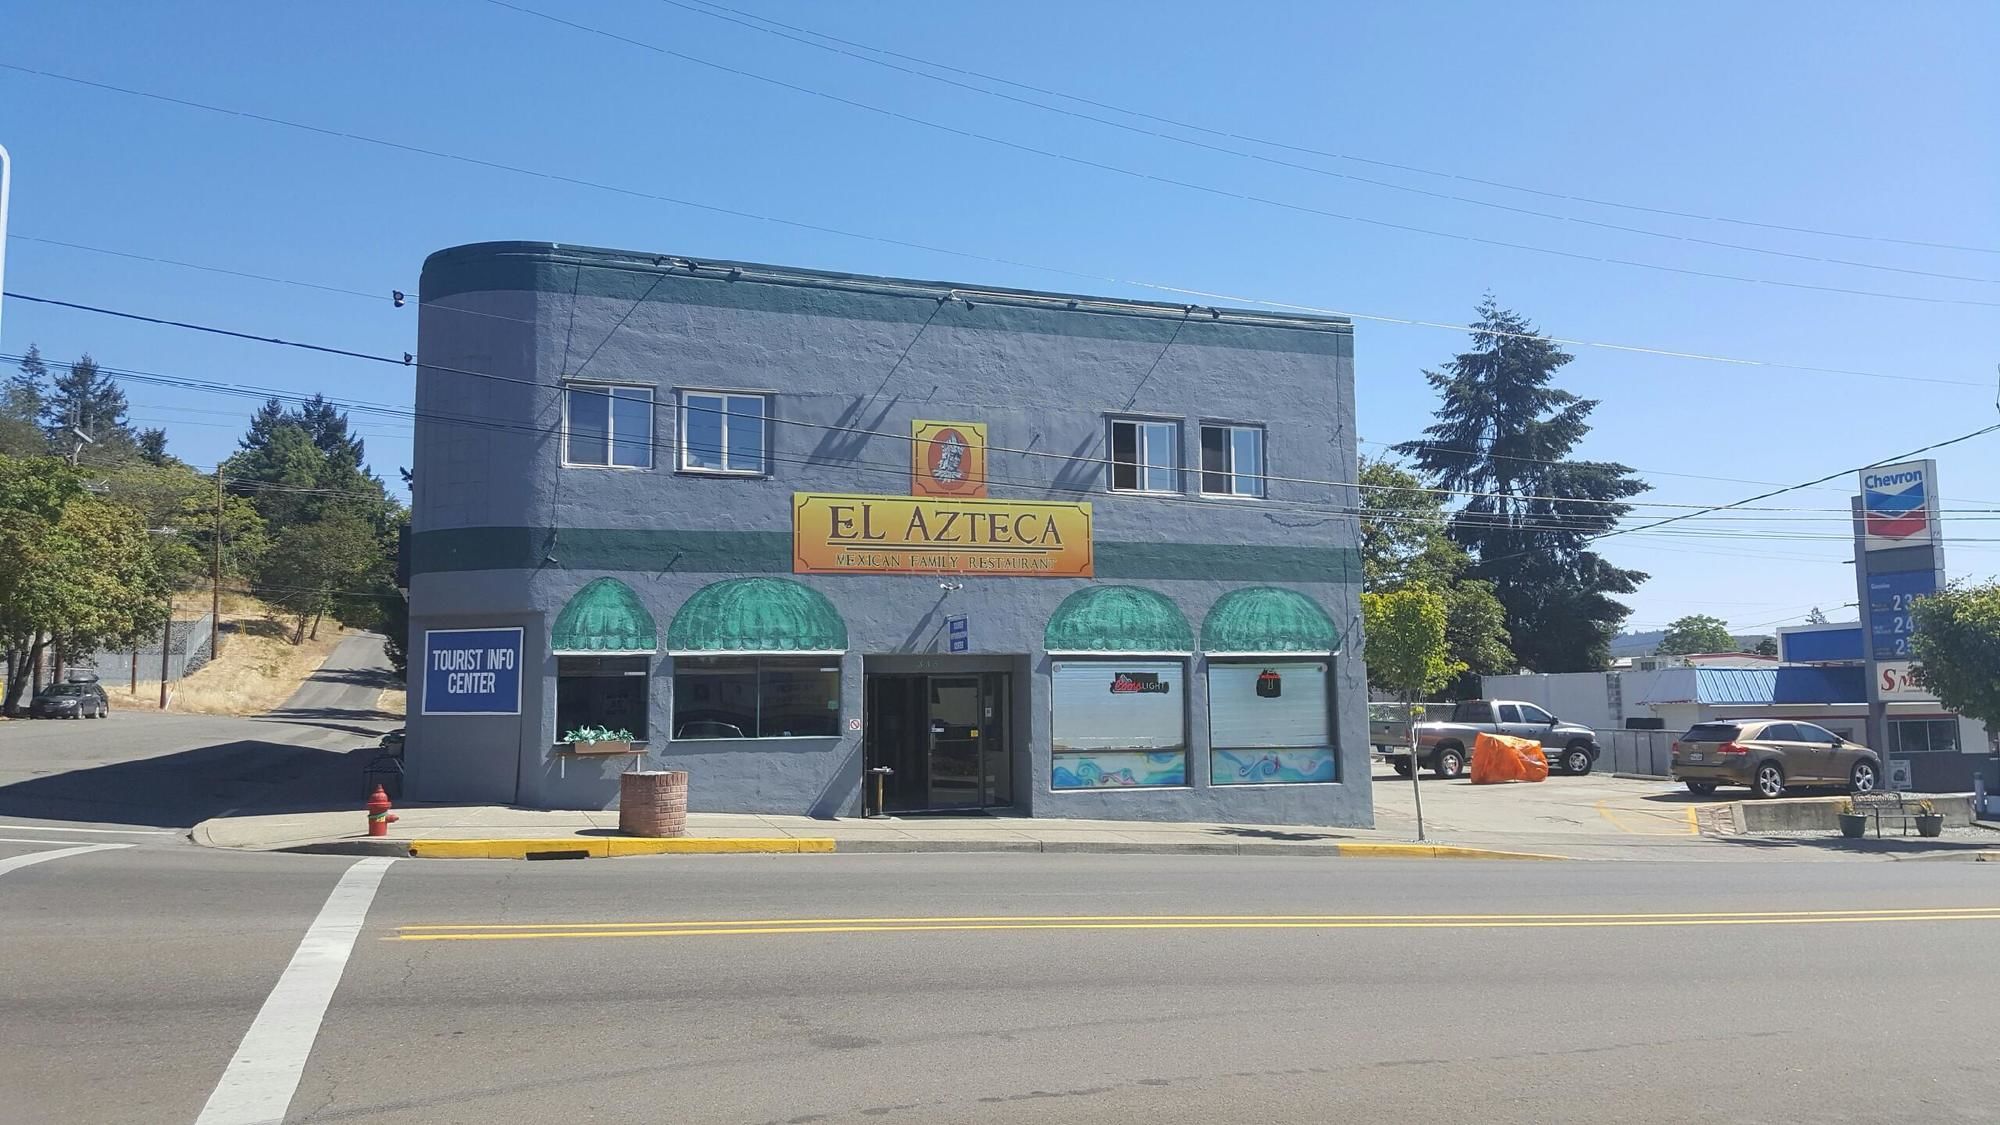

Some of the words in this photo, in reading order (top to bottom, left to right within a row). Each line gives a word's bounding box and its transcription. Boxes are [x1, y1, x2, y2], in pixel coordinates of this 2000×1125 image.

[1864, 470, 1922, 489] Chevron
[828, 502, 887, 540] EL
[904, 505, 1062, 544] AZTECA
[836, 554, 900, 567] MEXICAN
[911, 555, 958, 568] FAMILY
[969, 557, 1056, 569] RESTAURANT
[433, 649, 483, 670] TOURIST
[487, 648, 514, 670] INFO
[448, 672, 496, 694] CENTER
